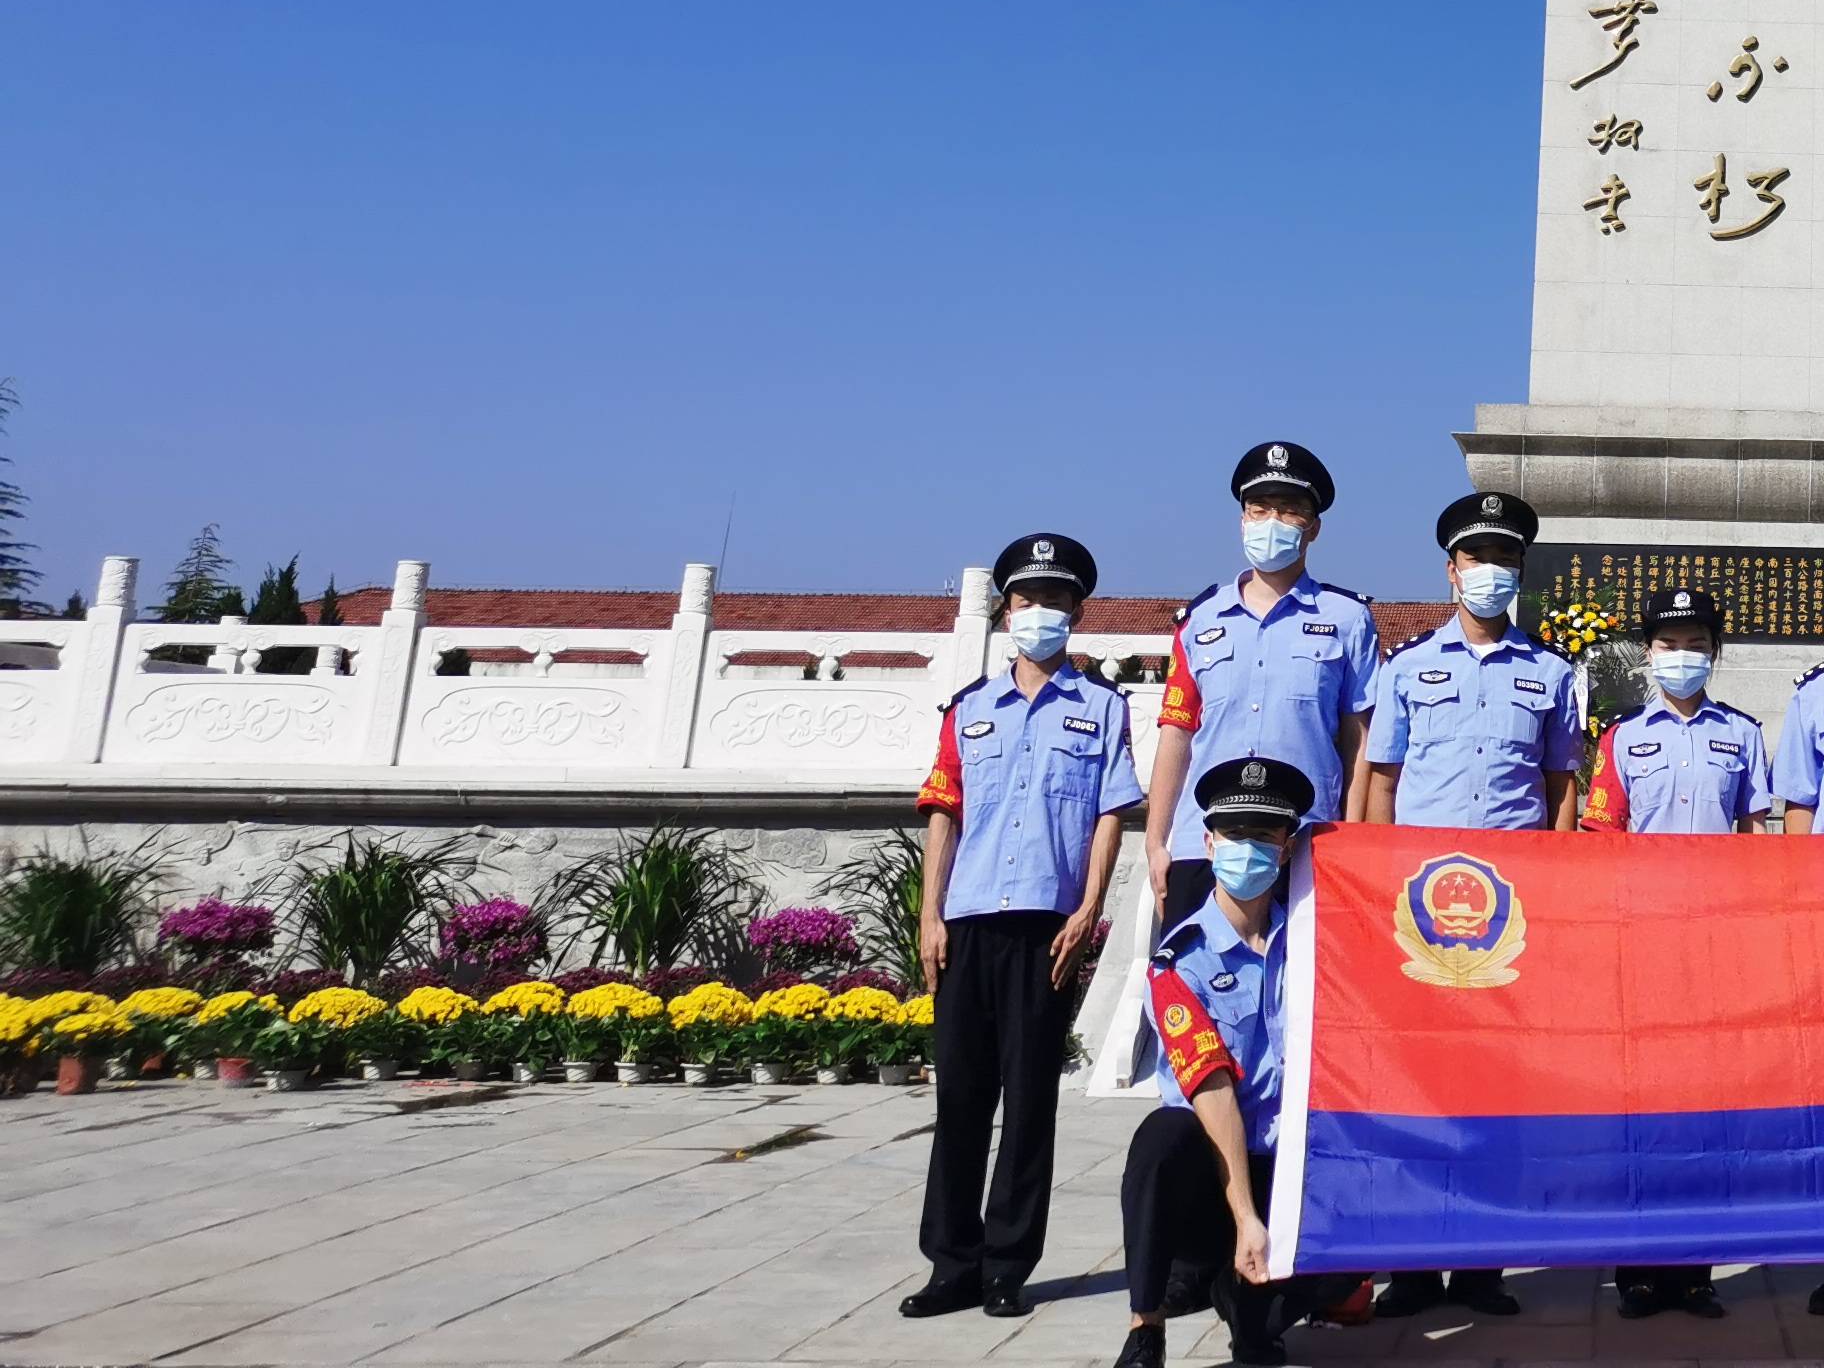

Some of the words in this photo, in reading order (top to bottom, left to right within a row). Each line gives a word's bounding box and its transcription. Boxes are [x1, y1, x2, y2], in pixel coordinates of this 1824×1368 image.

[1631, 554, 1644, 631] 是商丘市区唯一
[1753, 557, 1764, 632] 命烈士纪念碑一
[1782, 557, 1794, 635] 三百九十五米路
